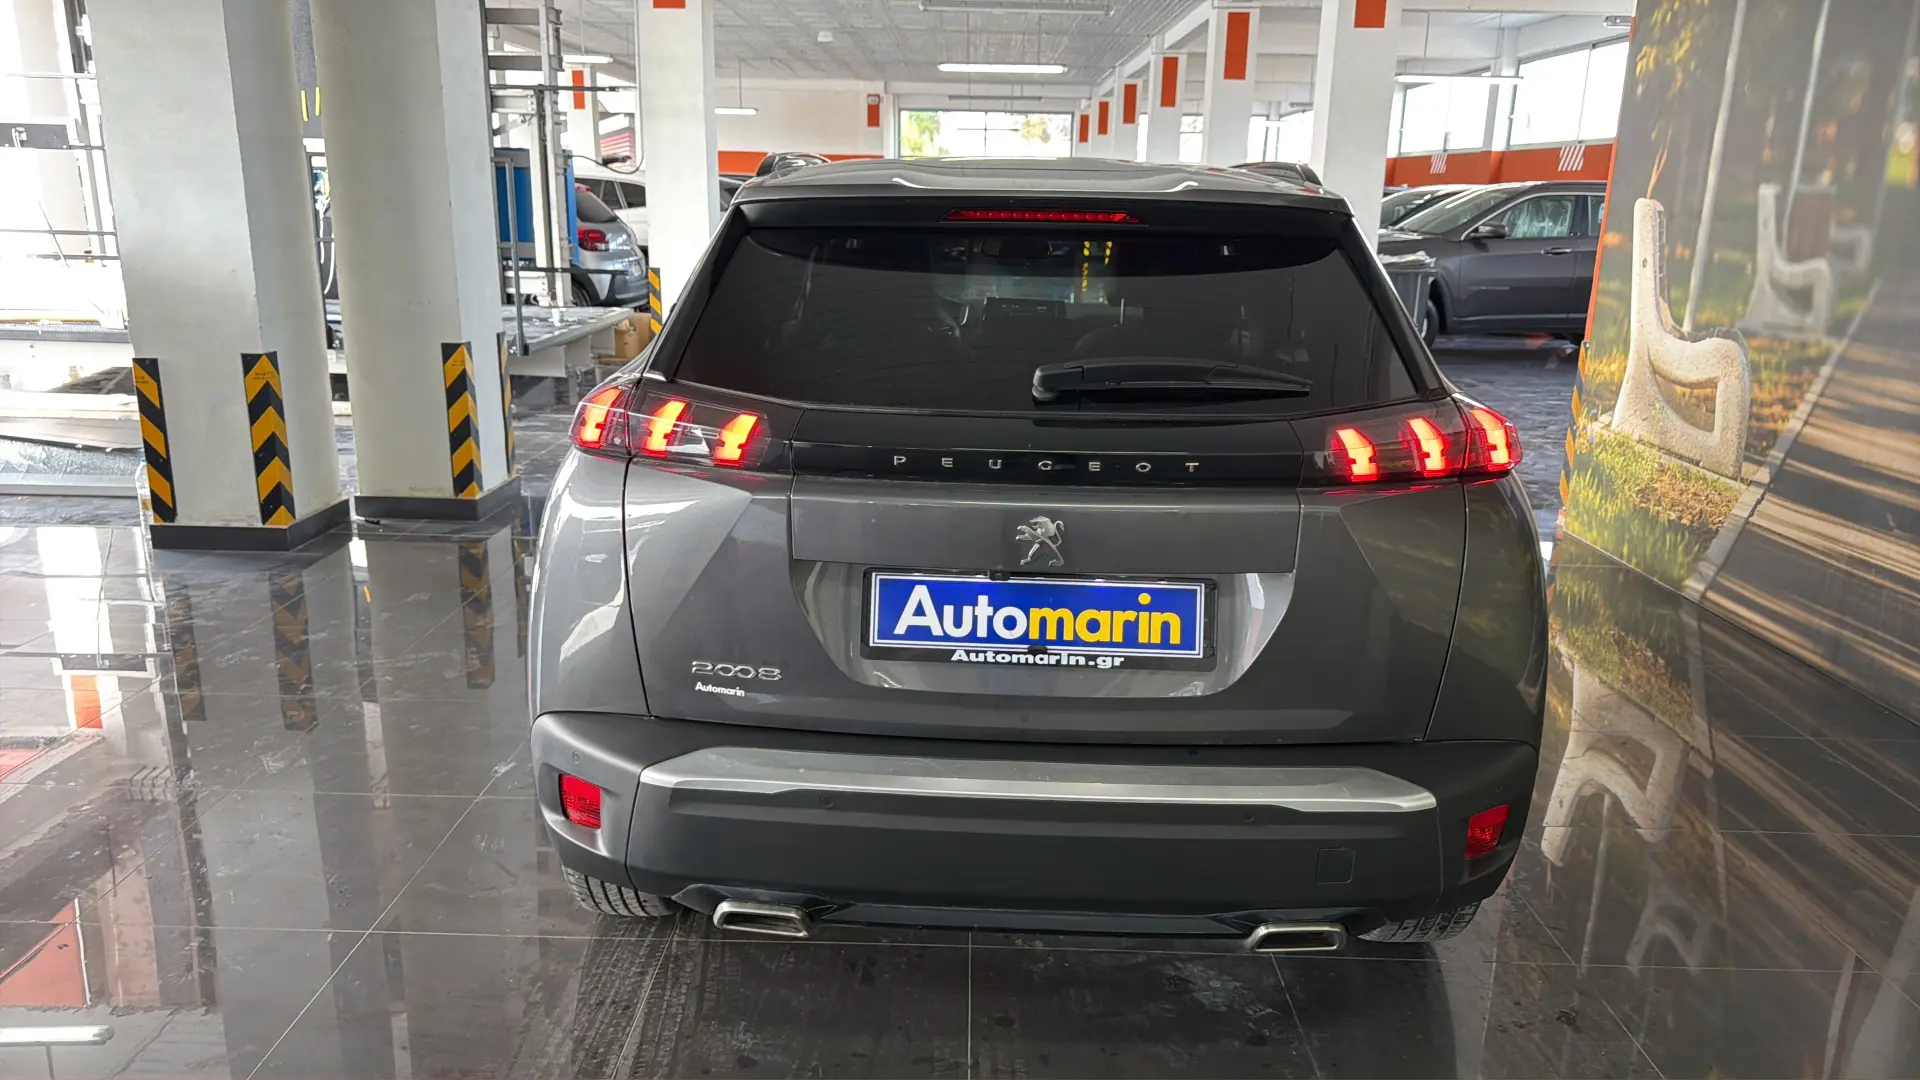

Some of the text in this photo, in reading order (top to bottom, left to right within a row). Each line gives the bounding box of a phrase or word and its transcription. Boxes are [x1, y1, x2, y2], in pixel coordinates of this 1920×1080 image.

[893, 456, 1200, 473] PEUGEOT
[893, 584, 1181, 645] Automarin
[950, 649, 1125, 669] Automarin.gr
[691, 661, 782, 681] 2008
[695, 681, 745, 697] Automarin
